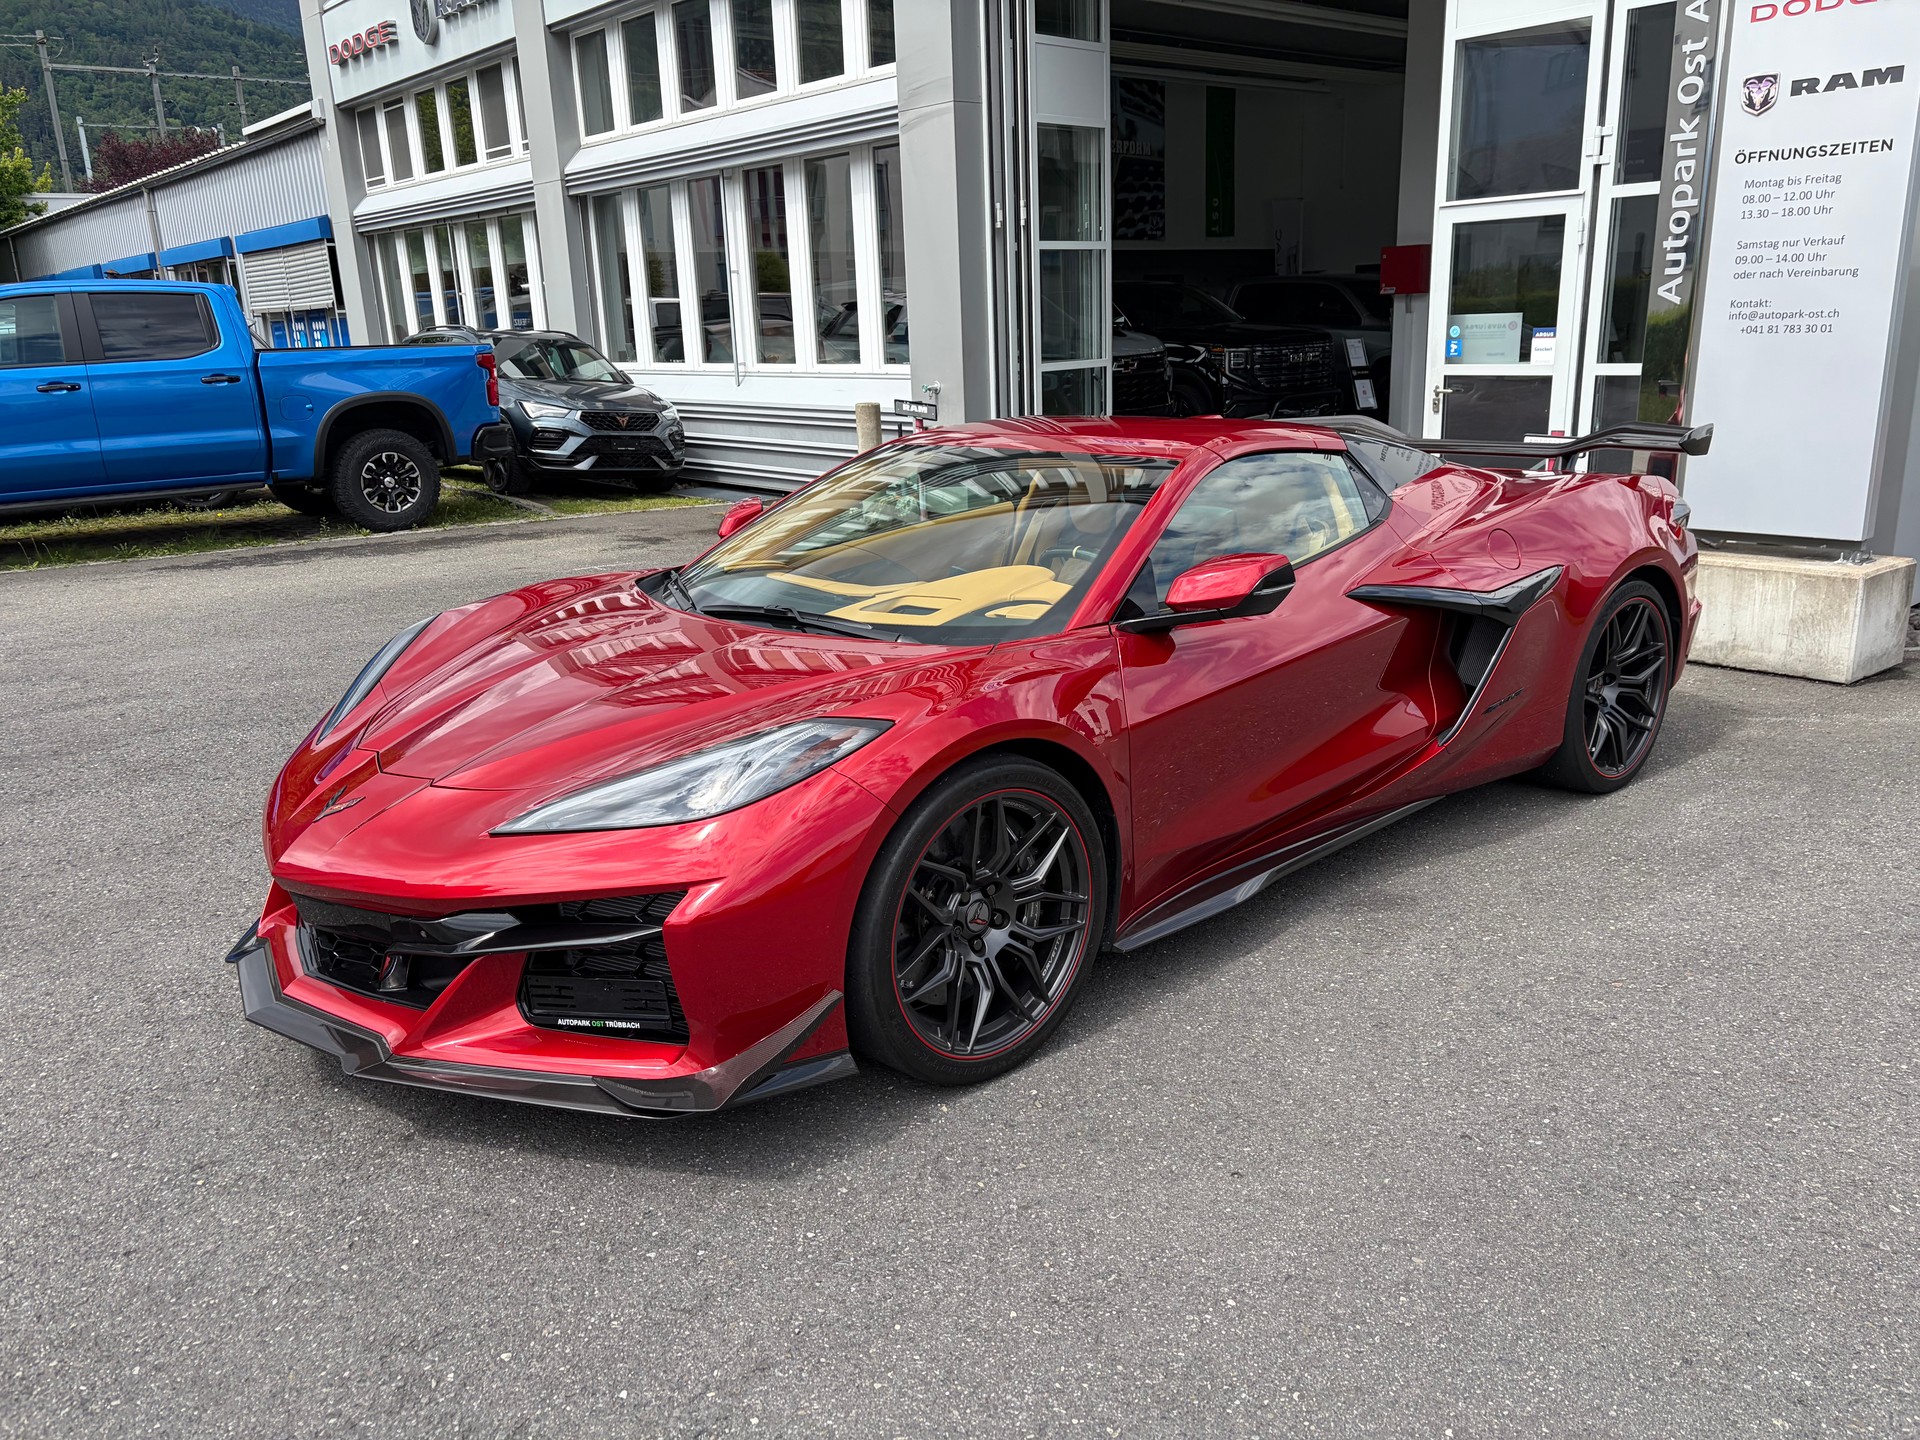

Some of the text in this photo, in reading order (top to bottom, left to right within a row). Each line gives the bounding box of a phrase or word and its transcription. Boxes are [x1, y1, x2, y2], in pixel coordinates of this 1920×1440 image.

[1750, 0, 1880, 23] DOD
[329, 20, 395, 65] DODGE
[1677, 36, 1709, 105] Ost
[1790, 65, 1905, 97] RAM
[1112, 139, 1152, 156] ERFORM
[1735, 138, 1894, 164] ÖFFNUNGSZEITEN
[1744, 174, 1842, 189] Montag bis Freitag
[1742, 193, 1771, 204] 08.00
[1783, 190, 1813, 202] 12.00
[1815, 189, 1835, 199] Uhr
[1657, 116, 1700, 305] Autopark
[1741, 209, 1769, 220] 13.30
[1781, 206, 1811, 217] 18.00
[1813, 205, 1834, 215] Uhr
[1737, 235, 1846, 250] Samstag nur Verkauf
[1735, 254, 1764, 265] 09.00
[1775, 252, 1804, 263] 14.00
[1807, 252, 1827, 262] Uhr
[1733, 267, 1859, 280] oder nach Vereinbarung
[1730, 299, 1772, 309] Kontakt:
[1728, 308, 1840, 321] info@autopark-ost.ch
[1740, 323, 1833, 334] +041 81 783 30 01
[903, 404, 928, 413] RAM
[558, 1018, 591, 1027] AUTOPARK
[605, 1020, 640, 1029] TRÜBBACH
